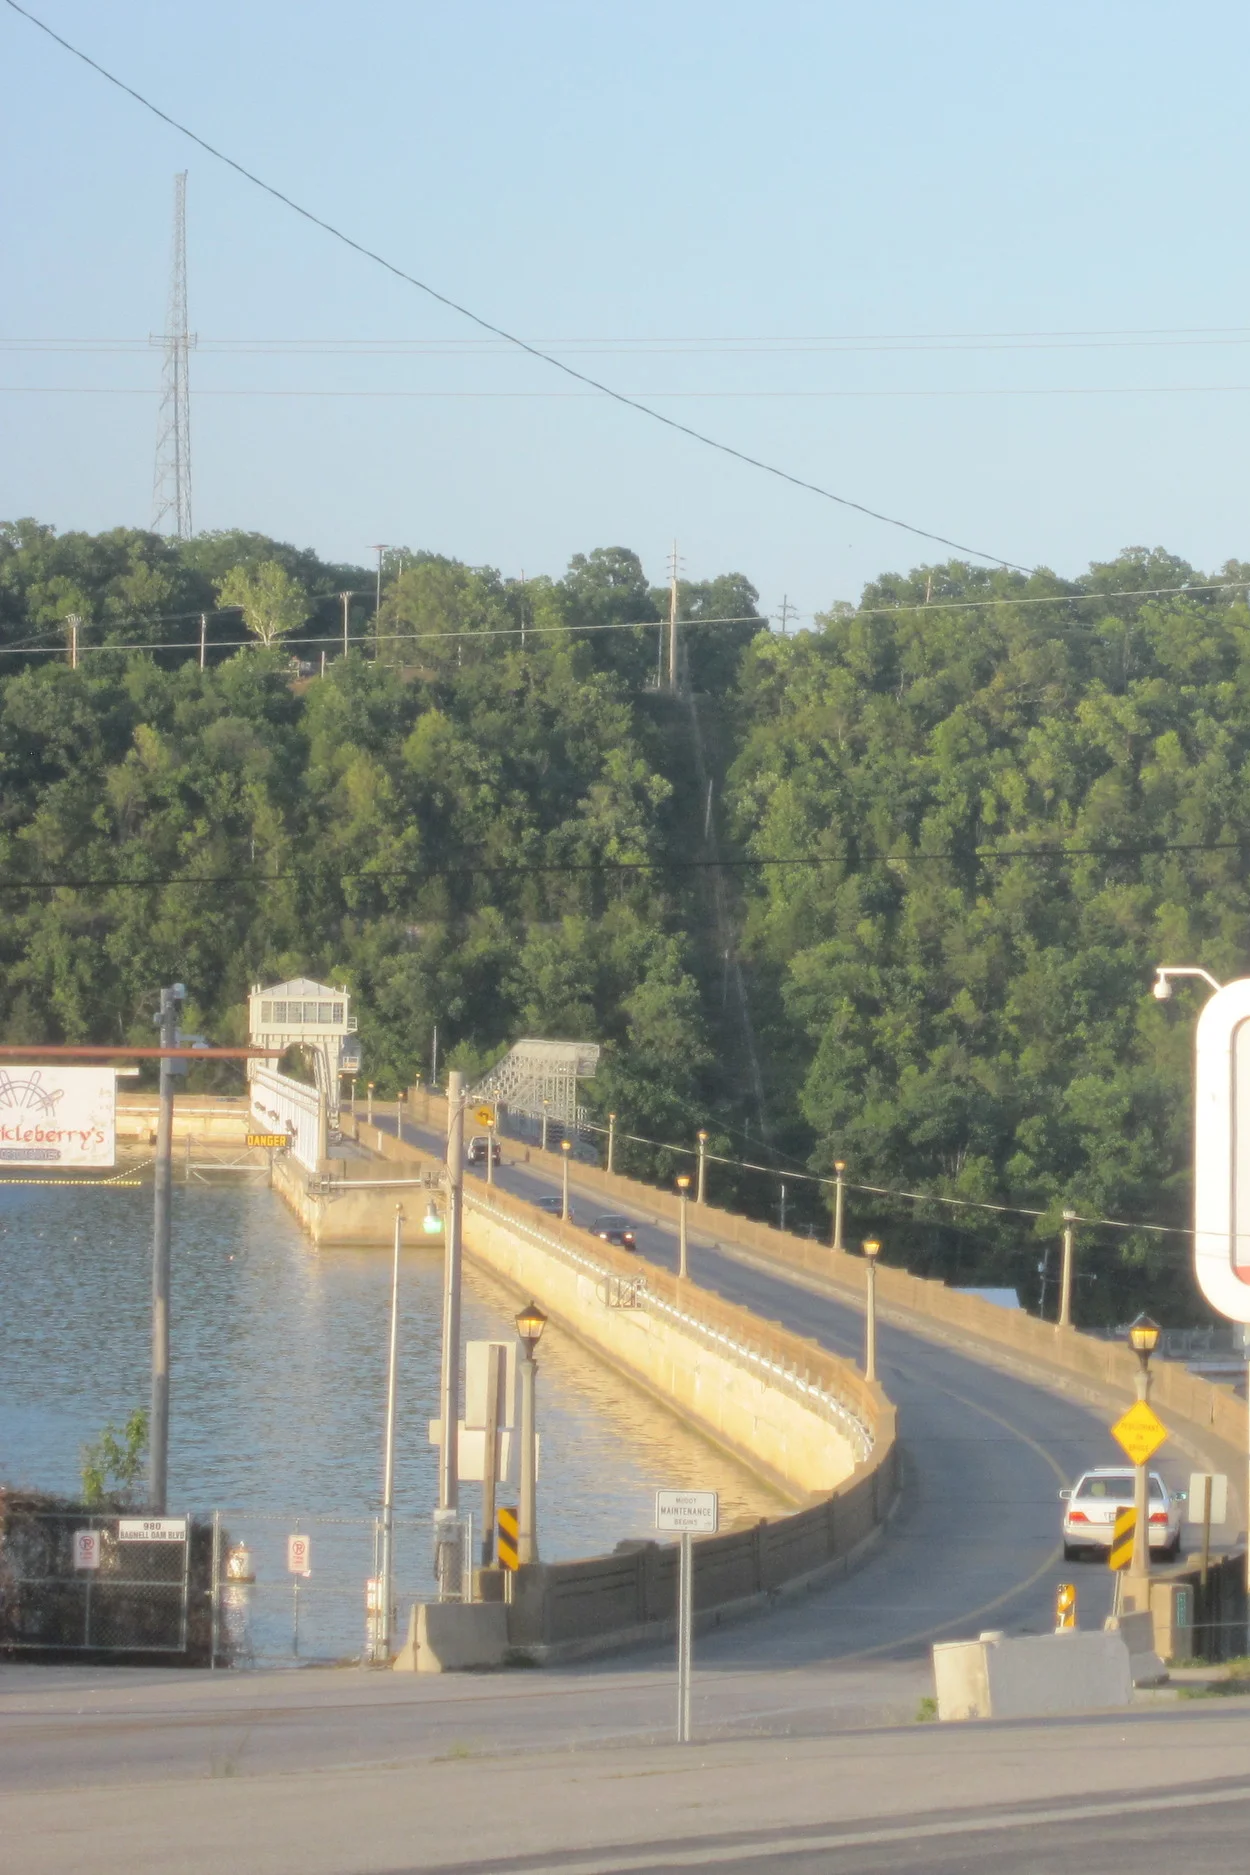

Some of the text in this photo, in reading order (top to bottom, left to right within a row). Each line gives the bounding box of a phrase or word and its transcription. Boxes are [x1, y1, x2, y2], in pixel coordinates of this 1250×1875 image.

[0, 1124, 104, 1150] kleberry's
[247, 1135, 286, 1147] DANGER
[660, 1507, 712, 1516] MAINTENANCE
[143, 1522, 162, 1531] 980
[120, 1531, 185, 1539] BAGNELL DAM BLVD
